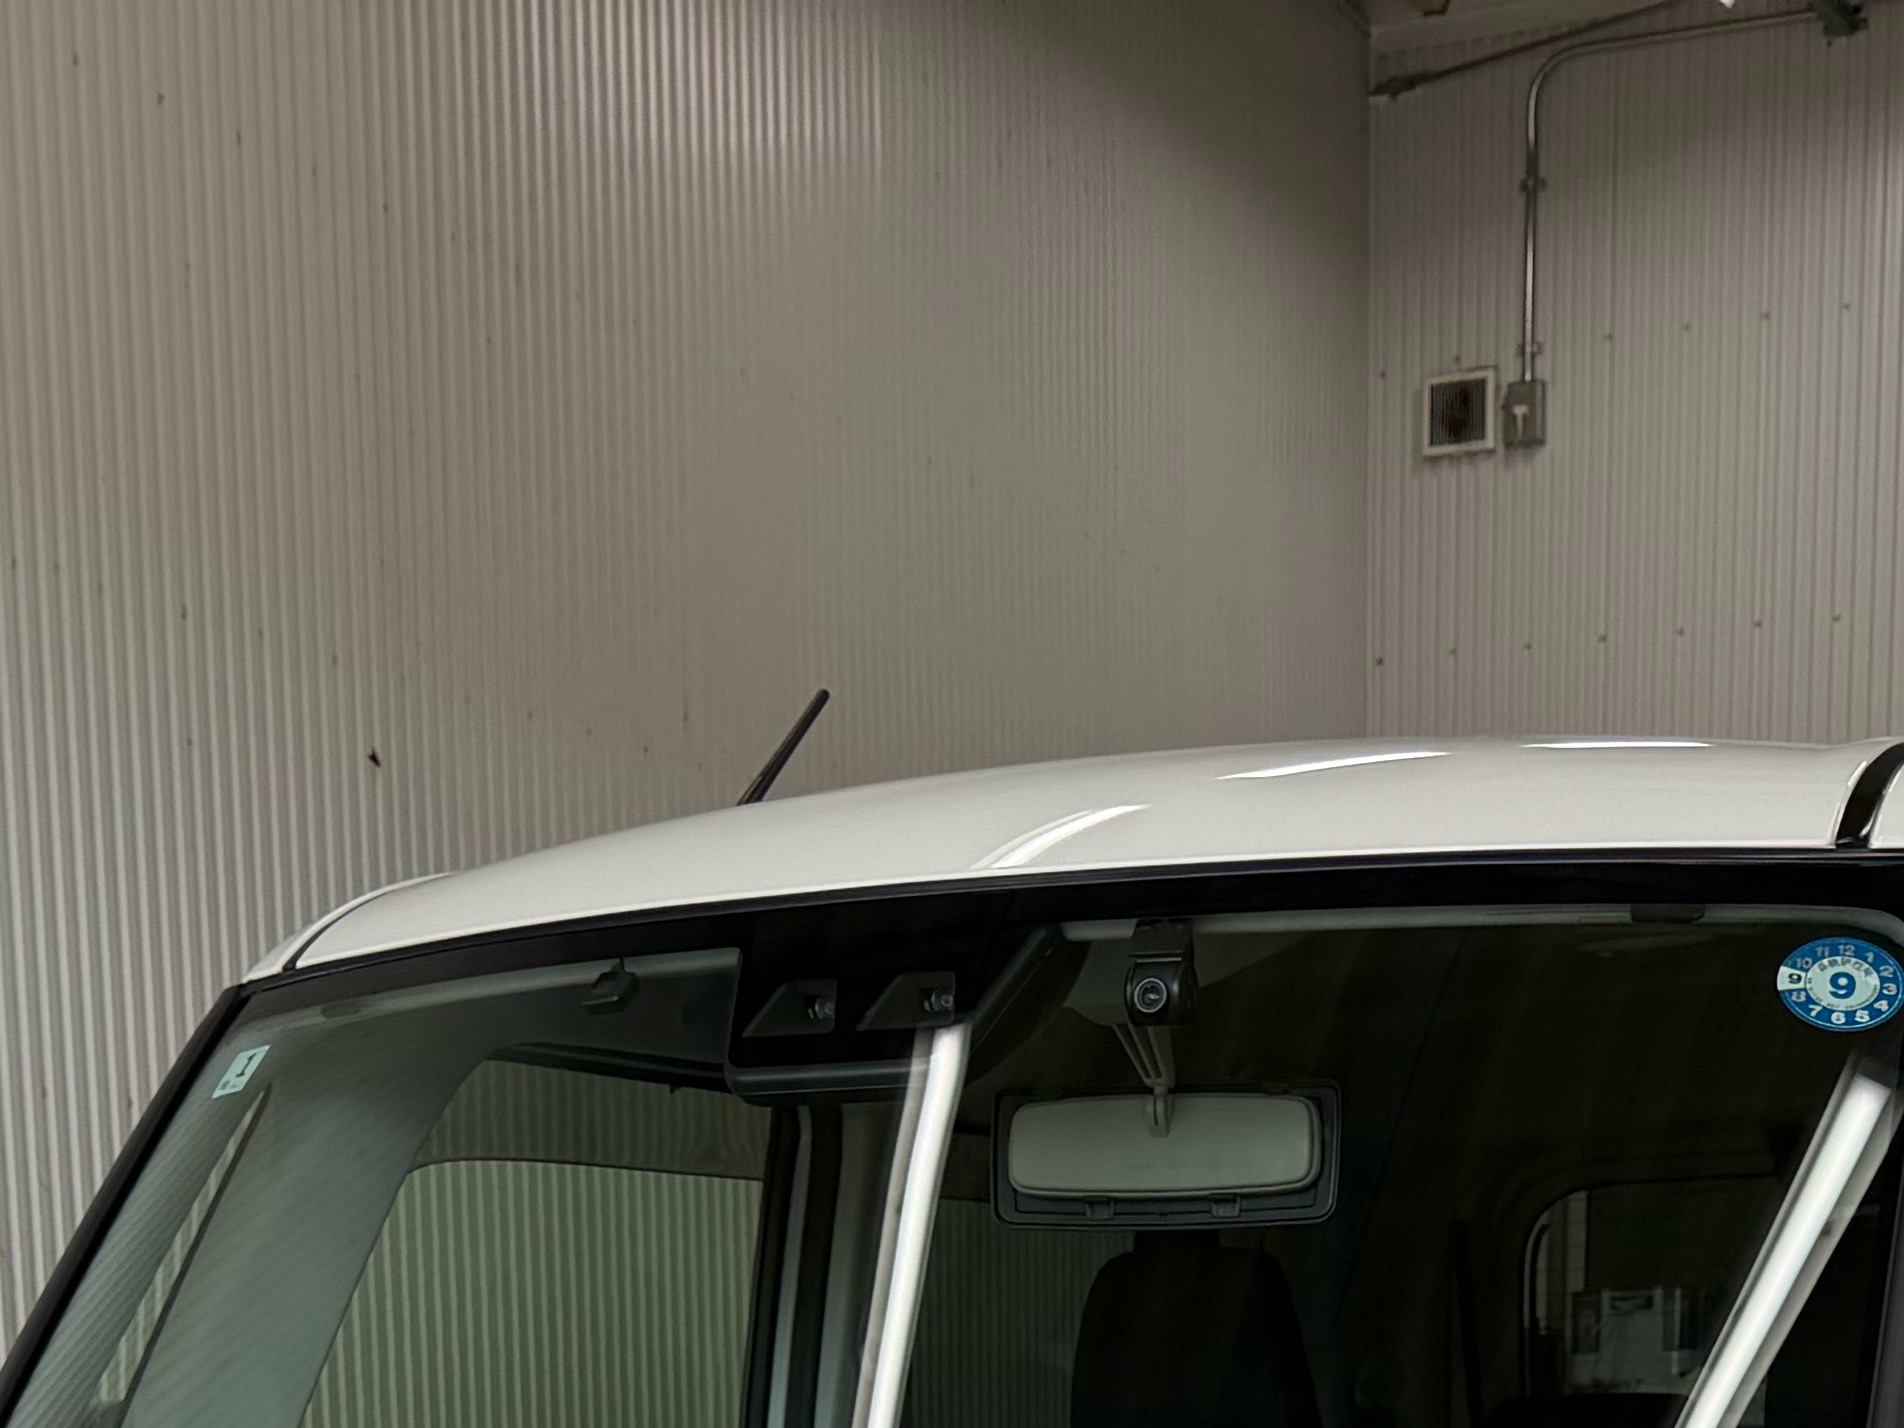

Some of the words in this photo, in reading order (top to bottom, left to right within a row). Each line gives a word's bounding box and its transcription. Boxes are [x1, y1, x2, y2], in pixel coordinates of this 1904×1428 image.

[1837, 945, 1855, 956] 12
[1796, 957, 1813, 969] 10
[1865, 952, 1874, 963] 1
[1879, 965, 1894, 978] 2
[1788, 972, 1802, 984] 9
[1829, 971, 1856, 1000] 9
[1882, 983, 1897, 995] 3
[1808, 1004, 1823, 1017] 7
[1873, 1000, 1889, 1012] 4
[1831, 1011, 1846, 1025] 6
[1854, 1009, 1870, 1023] 5
